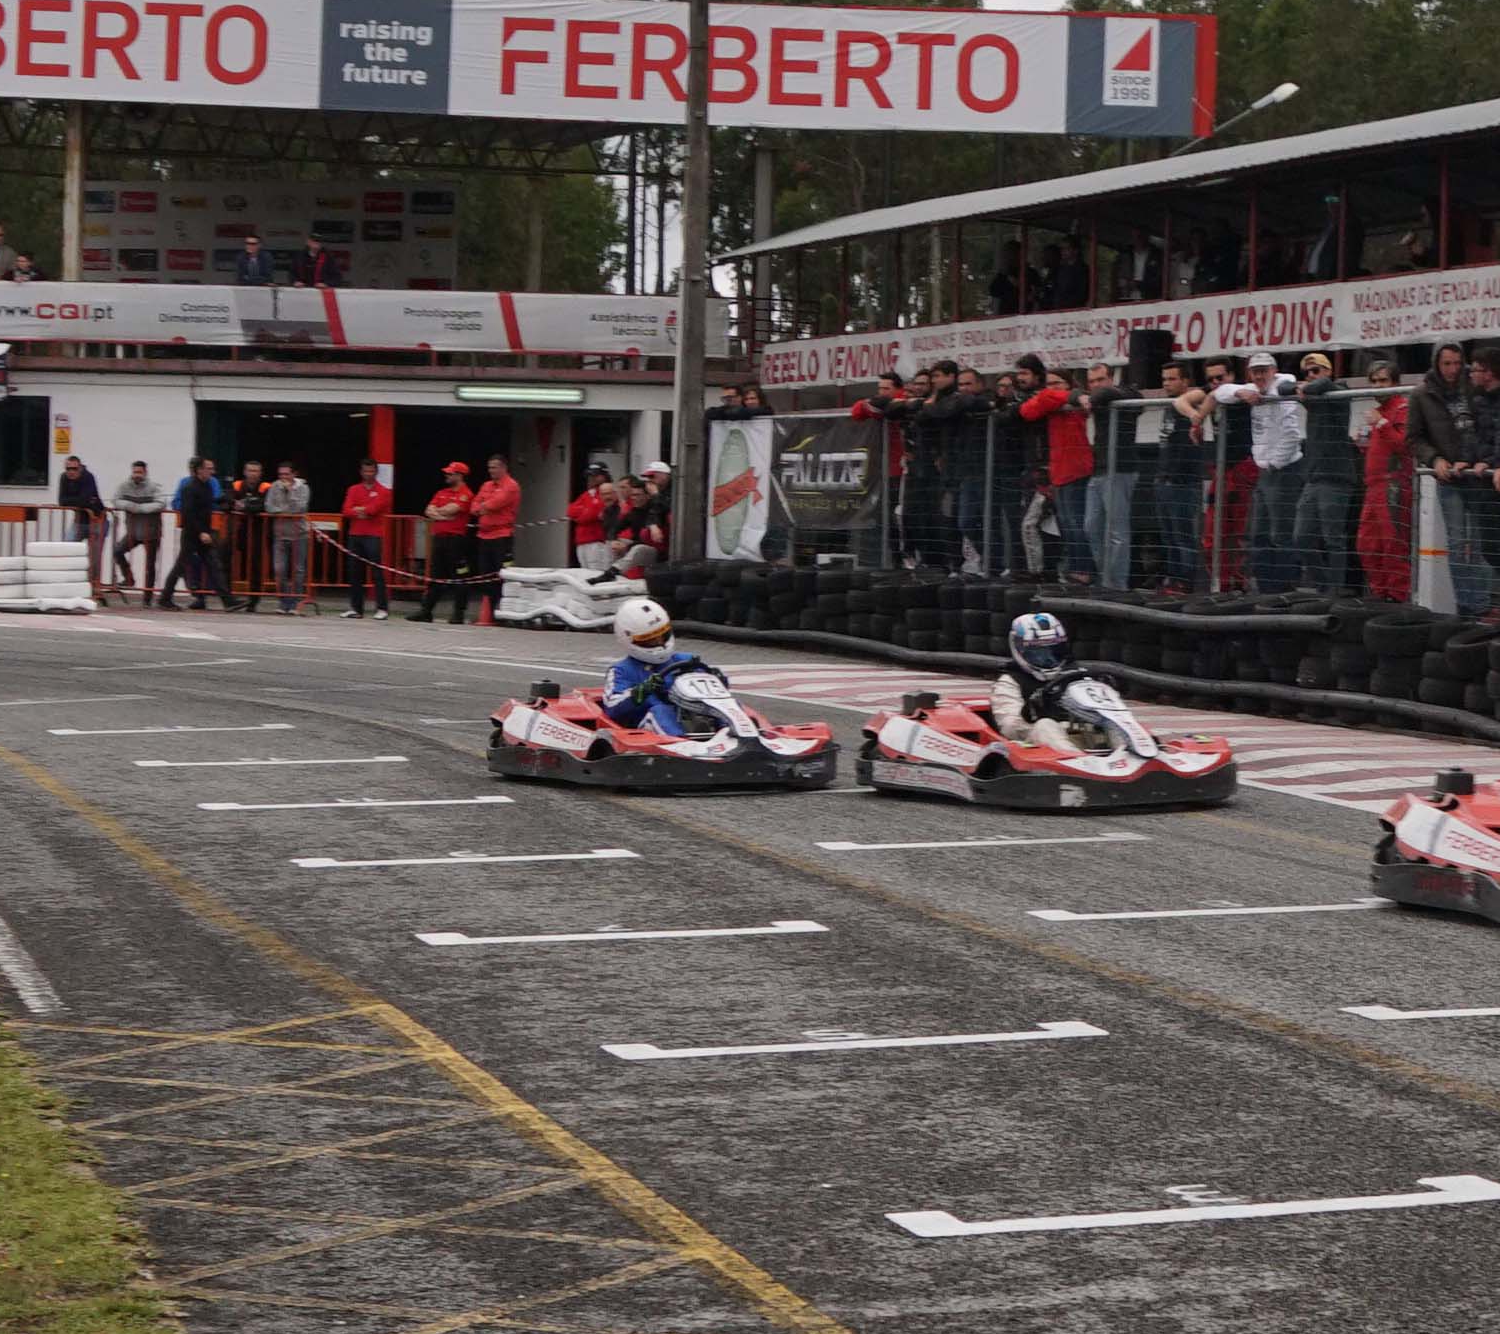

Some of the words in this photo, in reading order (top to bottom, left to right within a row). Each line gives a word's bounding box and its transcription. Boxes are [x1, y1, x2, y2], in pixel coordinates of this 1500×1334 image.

[339, 19, 434, 46] raising
[362, 42, 408, 63] the
[500, 15, 1020, 114] FERBERTO
[341, 61, 428, 85] future
[1110, 75, 1152, 86] since
[1110, 87, 1151, 101] 1996
[1217, 298, 1334, 350] VENDING
